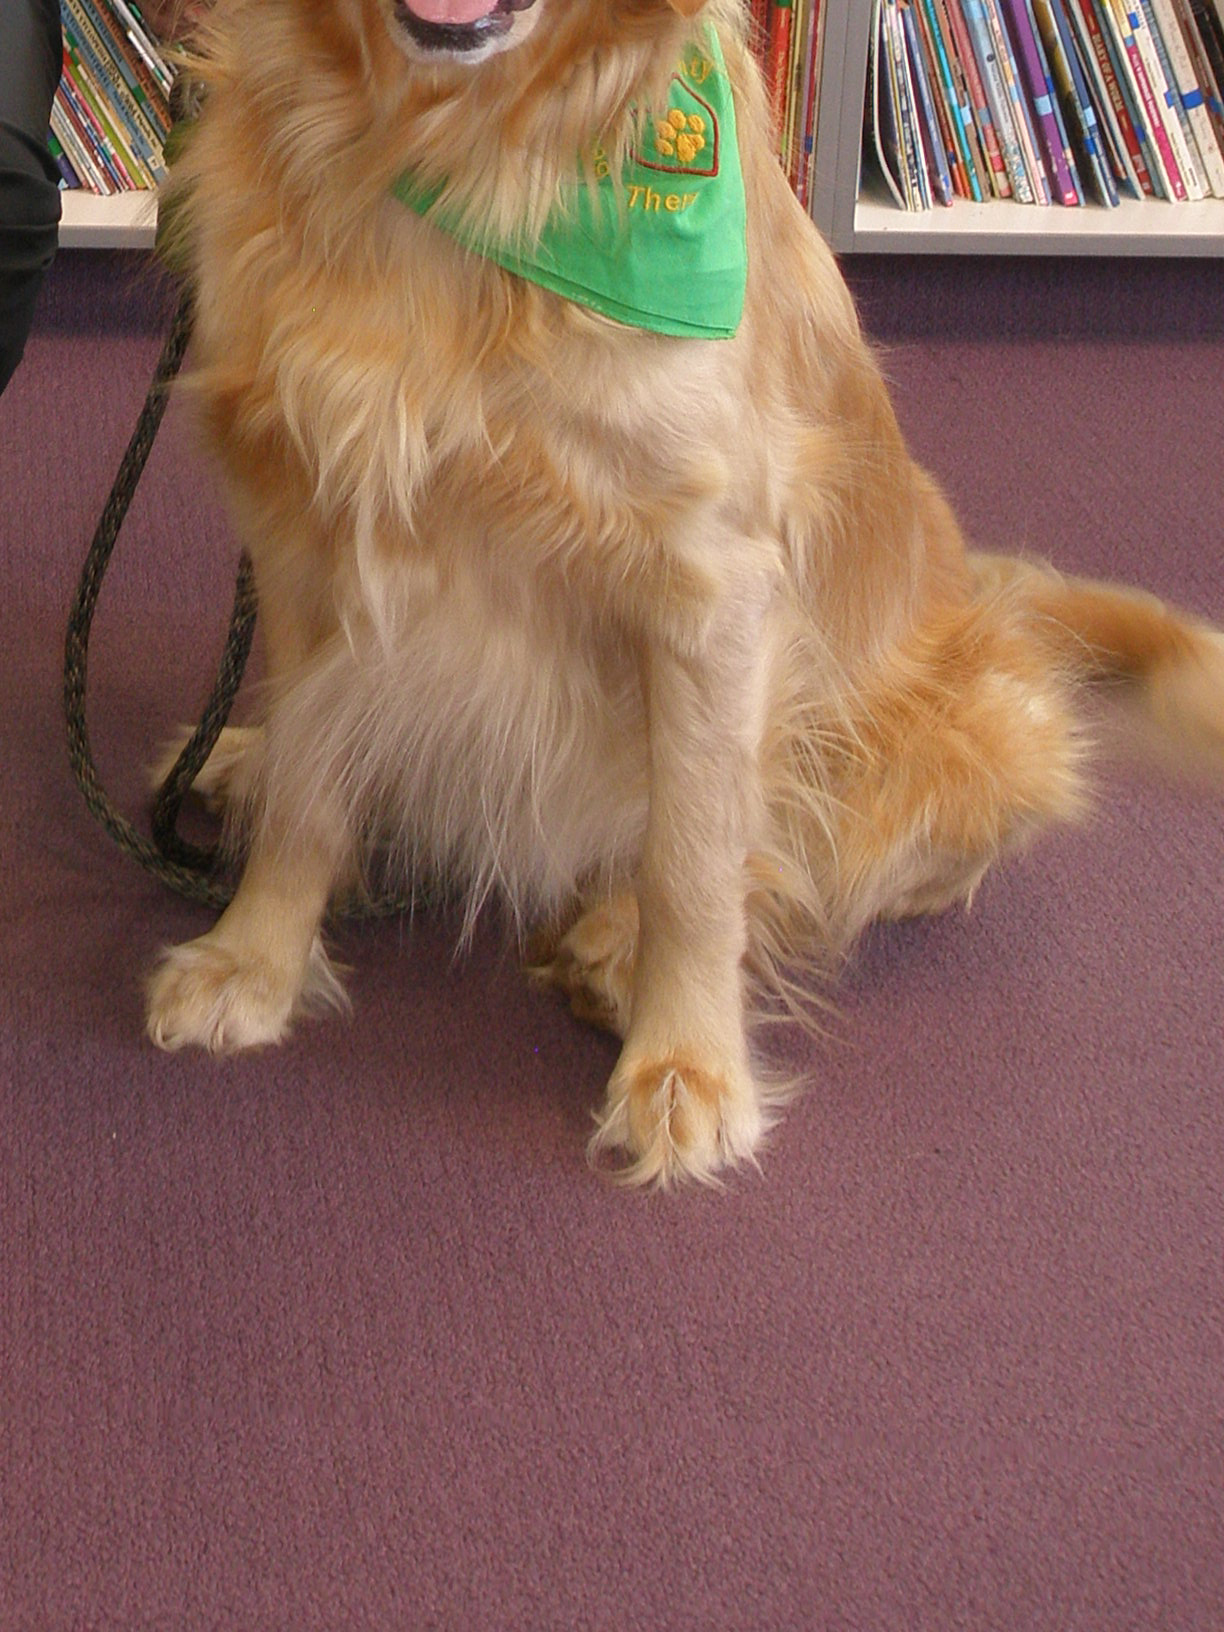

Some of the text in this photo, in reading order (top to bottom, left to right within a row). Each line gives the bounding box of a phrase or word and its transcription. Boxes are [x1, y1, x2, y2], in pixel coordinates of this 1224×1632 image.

[1091, 32, 1125, 112] DIARY OF A WORM
